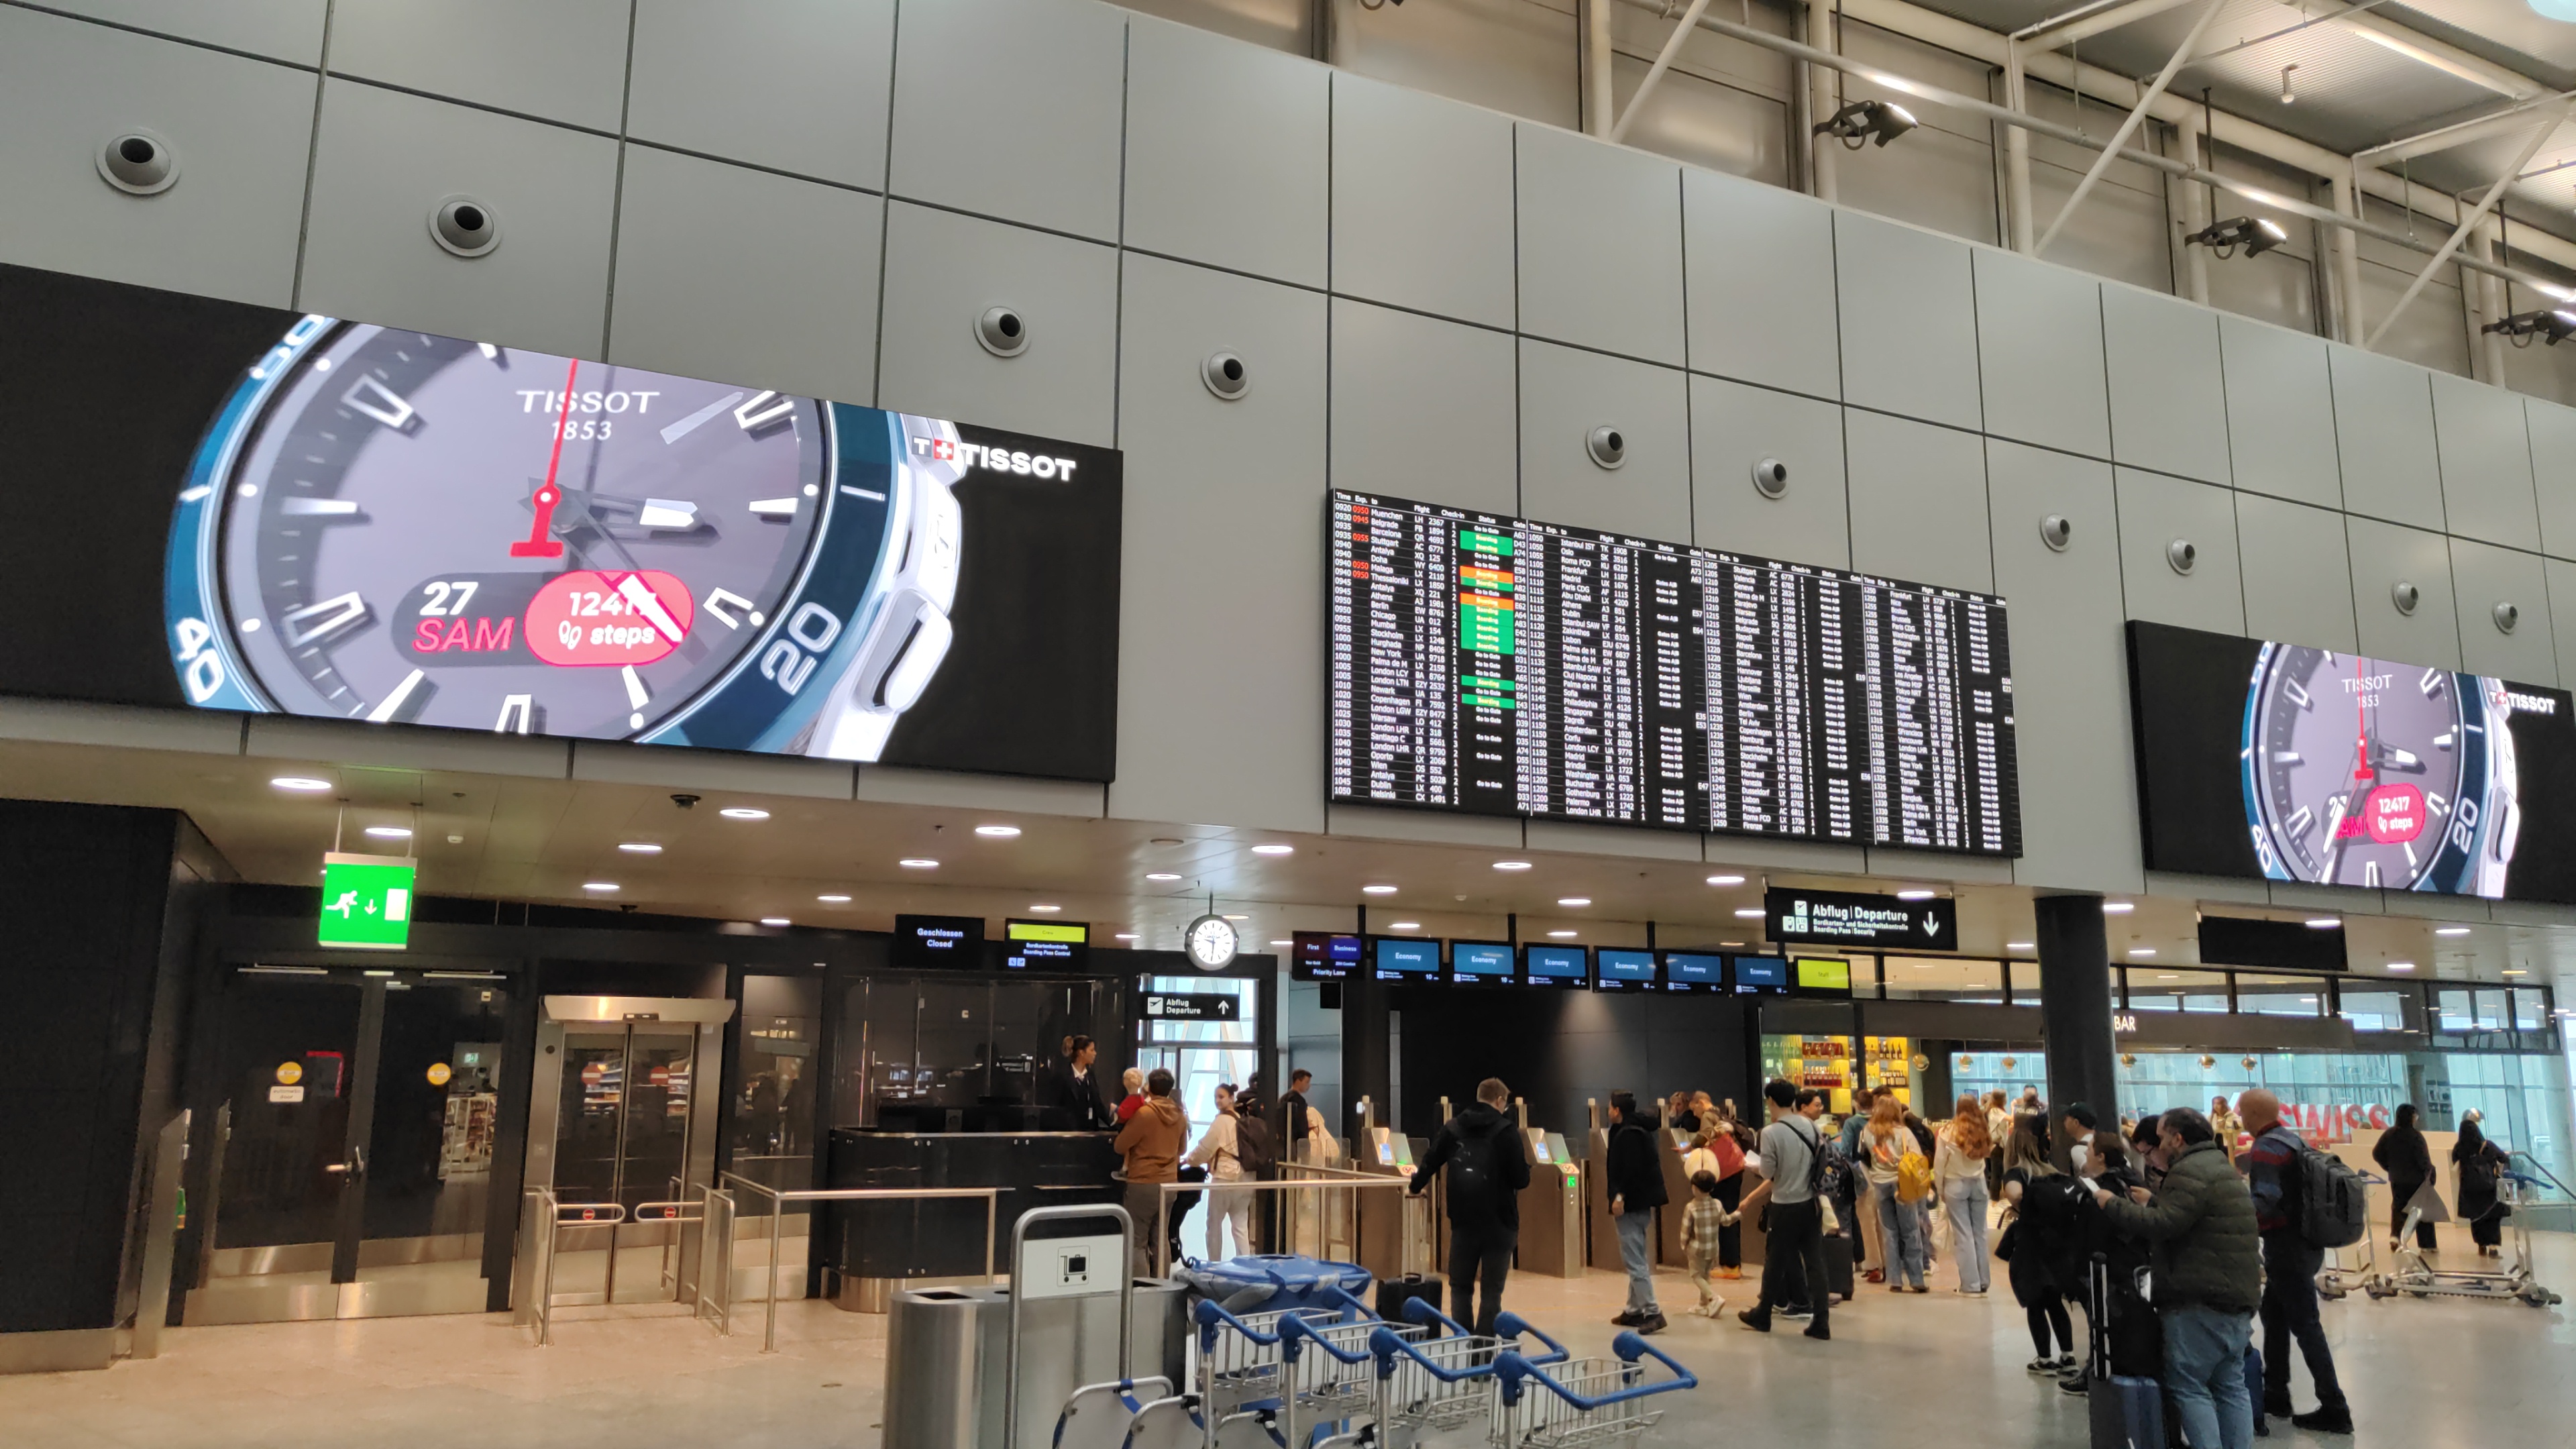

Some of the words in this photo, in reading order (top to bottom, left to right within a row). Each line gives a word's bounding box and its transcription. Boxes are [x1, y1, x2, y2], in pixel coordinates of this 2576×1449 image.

[516, 390, 660, 413] TISSOT
[552, 421, 611, 440] 1853
[959, 443, 1076, 482] TISSOT
[1335, 502, 1352, 512] 0920
[1352, 505, 1368, 514] 0950
[1371, 508, 1403, 520] Muenchen
[1414, 515, 1423, 523] LH
[1428, 517, 1444, 526] 2367
[1336, 492, 1350, 500] Time
[1355, 495, 1367, 504] Exp.
[1414, 504, 1430, 513] Flight
[1441, 509, 1464, 519] Check-in
[1478, 515, 1495, 524] Status
[1513, 521, 1525, 529] Gate
[1335, 512, 1352, 521] 0930
[1352, 515, 1368, 523] 0945
[1371, 518, 1398, 529] Belgrade
[1415, 524, 1423, 532] FB
[1429, 527, 1444, 535] 1894
[1371, 527, 1401, 538] Barcelona
[1334, 530, 1351, 539] 0935
[1352, 533, 1368, 541] 0955
[1371, 536, 1399, 547] Stuttgart
[1371, 545, 1394, 555] Antalya
[1371, 554, 1387, 564] Doha
[1334, 557, 1352, 568] 0940
[1352, 561, 1368, 570] 0950
[1371, 564, 1393, 574] Malaga
[1335, 567, 1351, 576] 0940
[1352, 570, 1368, 578] 0950
[1371, 572, 1408, 585] Thessaloniki
[1371, 582, 1395, 592] Antalya
[420, 582, 478, 615] 27
[570, 592, 656, 616] 1241
[1371, 592, 1393, 601] Athens
[1371, 600, 1389, 610] Berlin
[1371, 610, 1396, 620] Chicago
[1371, 619, 1396, 629] Mumbai
[413, 616, 515, 653] SAM
[590, 624, 655, 649] steps
[1371, 629, 1403, 639] Stockholm
[761, 602, 841, 696] 20
[1371, 638, 1401, 649] Hurghada
[1371, 647, 1385, 656] New
[1386, 649, 1401, 658] York
[177, 617, 225, 702] 40
[1371, 656, 1390, 666] Palma
[1391, 659, 1400, 667] de
[1371, 666, 1395, 676] London
[1395, 669, 1408, 677] LCY
[1371, 675, 1395, 685] London
[1395, 678, 1409, 687] LTN
[2341, 674, 2393, 693] TISSOT
[1371, 684, 1395, 694] Newark
[1371, 694, 1410, 706] Copenhagen
[2357, 694, 2379, 708] 1853
[2508, 692, 2555, 713] TISSOT
[1371, 704, 1395, 713] London
[1395, 706, 1411, 715] LGW
[1371, 713, 1396, 723] Warsaw
[1371, 722, 1395, 732] London
[1396, 725, 1409, 734] LHR
[1371, 732, 1399, 743] Santiago
[1399, 735, 1405, 743] C
[1371, 741, 1395, 751] London
[1396, 744, 1409, 753] LHR
[1371, 751, 1393, 761] Oporto
[1371, 761, 1387, 769] Wien
[1371, 770, 1395, 780] Antalya
[1371, 780, 1391, 789] Dublin
[1371, 790, 1395, 799] Helsinki
[2379, 796, 2410, 813] 12417
[2335, 816, 2364, 839] AM
[2390, 816, 2413, 831] steps
[2453, 797, 2478, 854] 20
[1813, 904, 1848, 920] Abflug
[1854, 906, 1908, 922] Departure
[1813, 926, 1837, 934] Boarding
[1854, 928, 1876, 936] Security
[1858, 921, 1909, 930] Sicherheitskontrolle
[917, 928, 963, 938] Geschlossen
[927, 939, 953, 948] Closed
[1395, 953, 1421, 961] Economy
[1471, 956, 1497, 965] Economy
[1545, 959, 1569, 967] Economy
[1615, 962, 1638, 971] Economy
[1313, 969, 1332, 977] Priority
[1683, 965, 1706, 973] Economy
[1750, 968, 1772, 976] Economy
[1167, 998, 1189, 1007] Abflug
[2114, 1016, 2136, 1031] BAR
